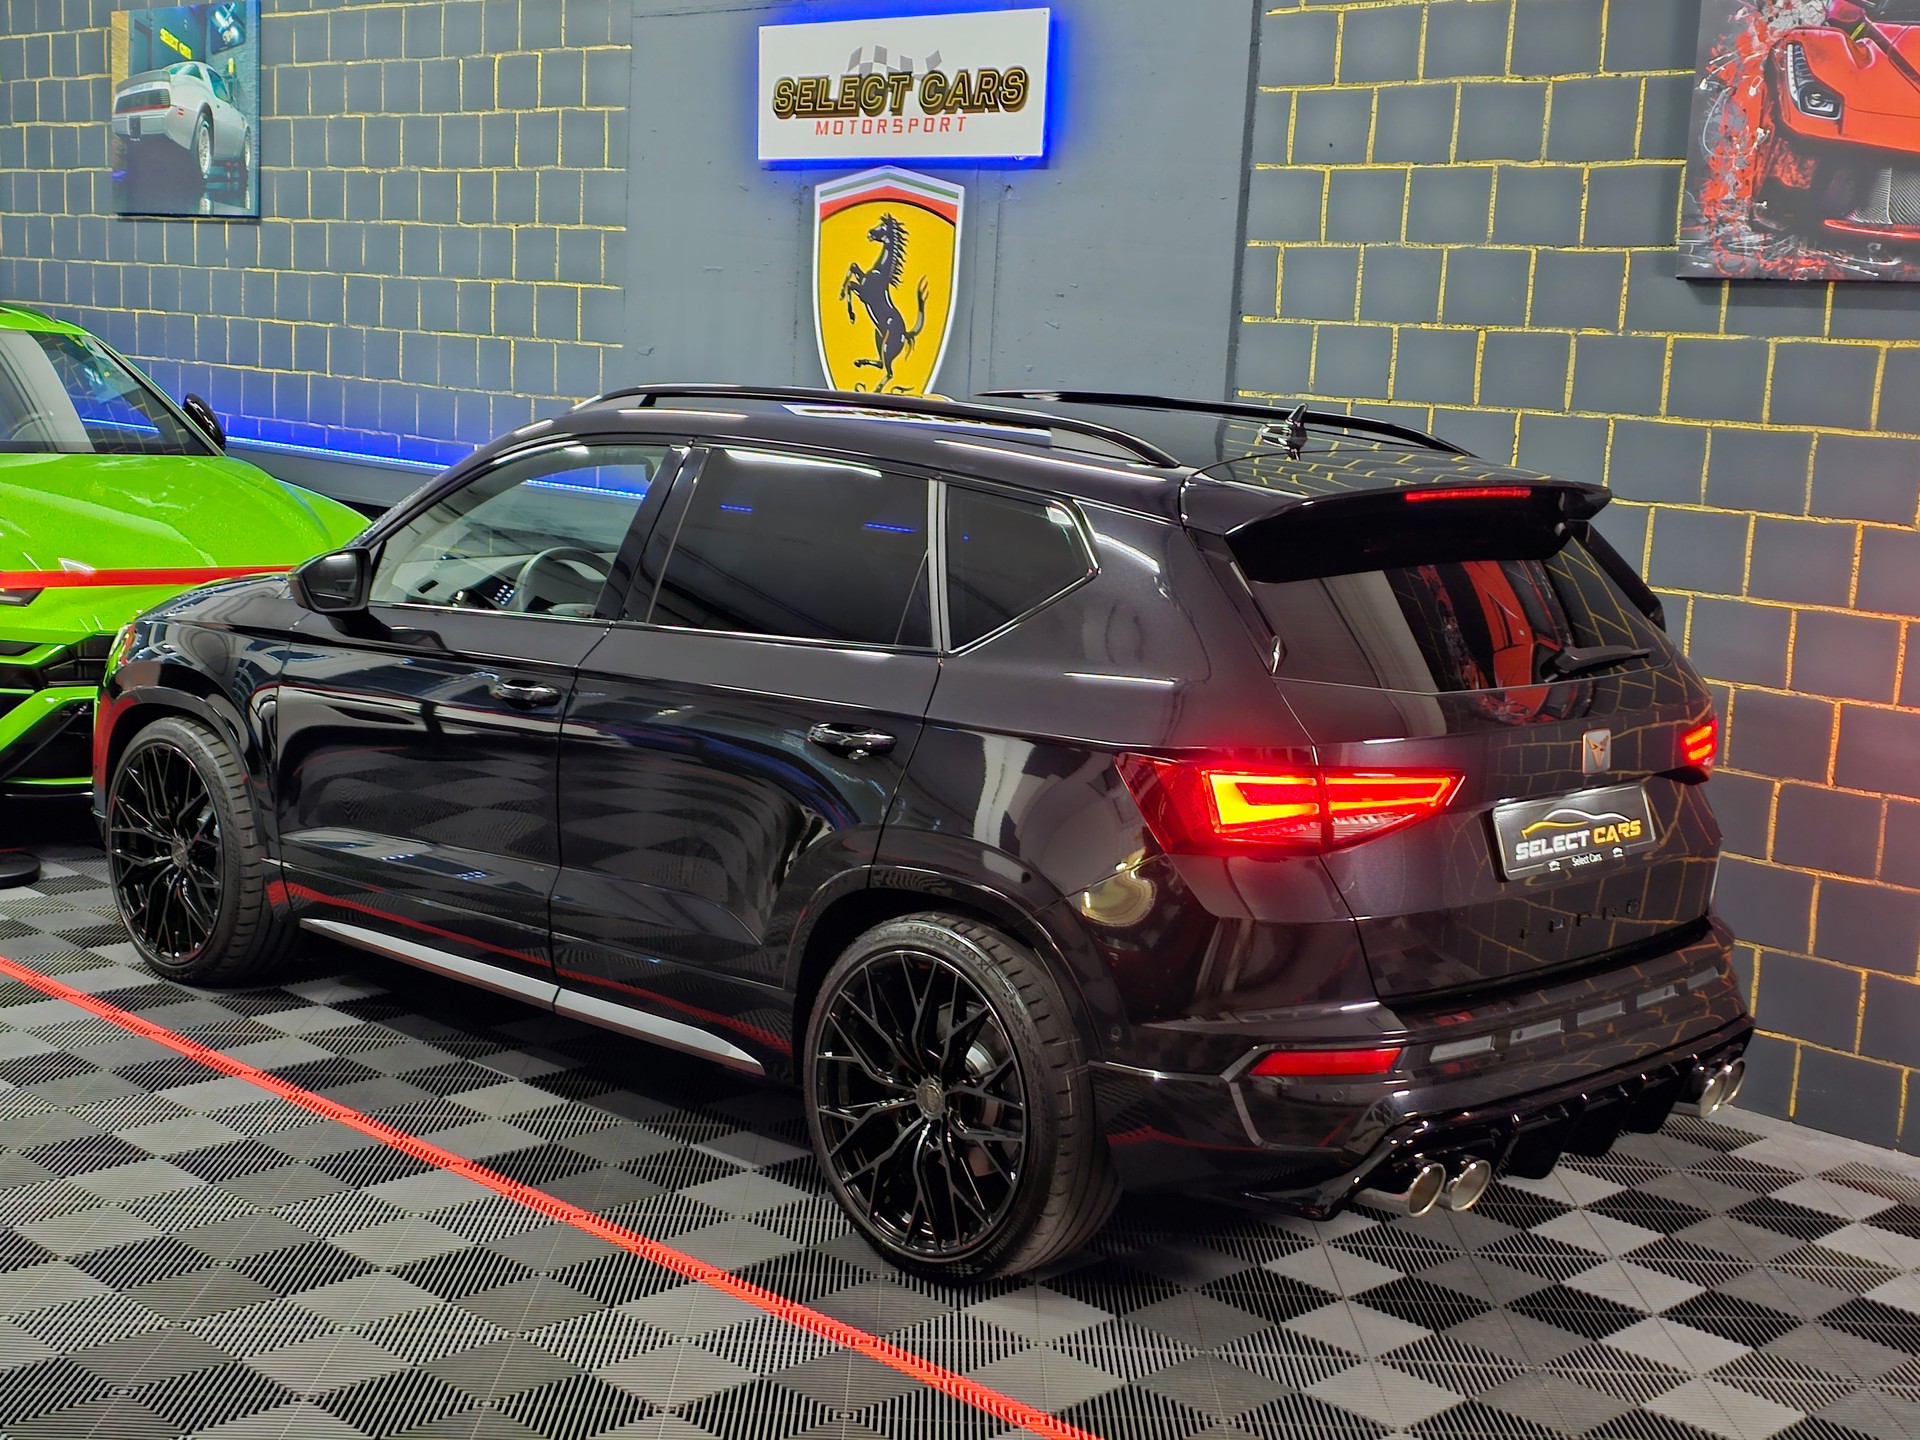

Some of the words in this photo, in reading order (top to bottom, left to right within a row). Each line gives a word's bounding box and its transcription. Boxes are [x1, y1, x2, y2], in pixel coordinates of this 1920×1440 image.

[772, 71, 913, 119] SELECT
[918, 65, 1030, 115] CARS
[815, 116, 967, 136] MOTORSPORT
[1515, 830, 1591, 861] SELECT
[1592, 819, 1642, 844] CARS
[1571, 854, 1589, 867] Select
[1589, 852, 1603, 864] Cars
[906, 926, 943, 940] 245/35
